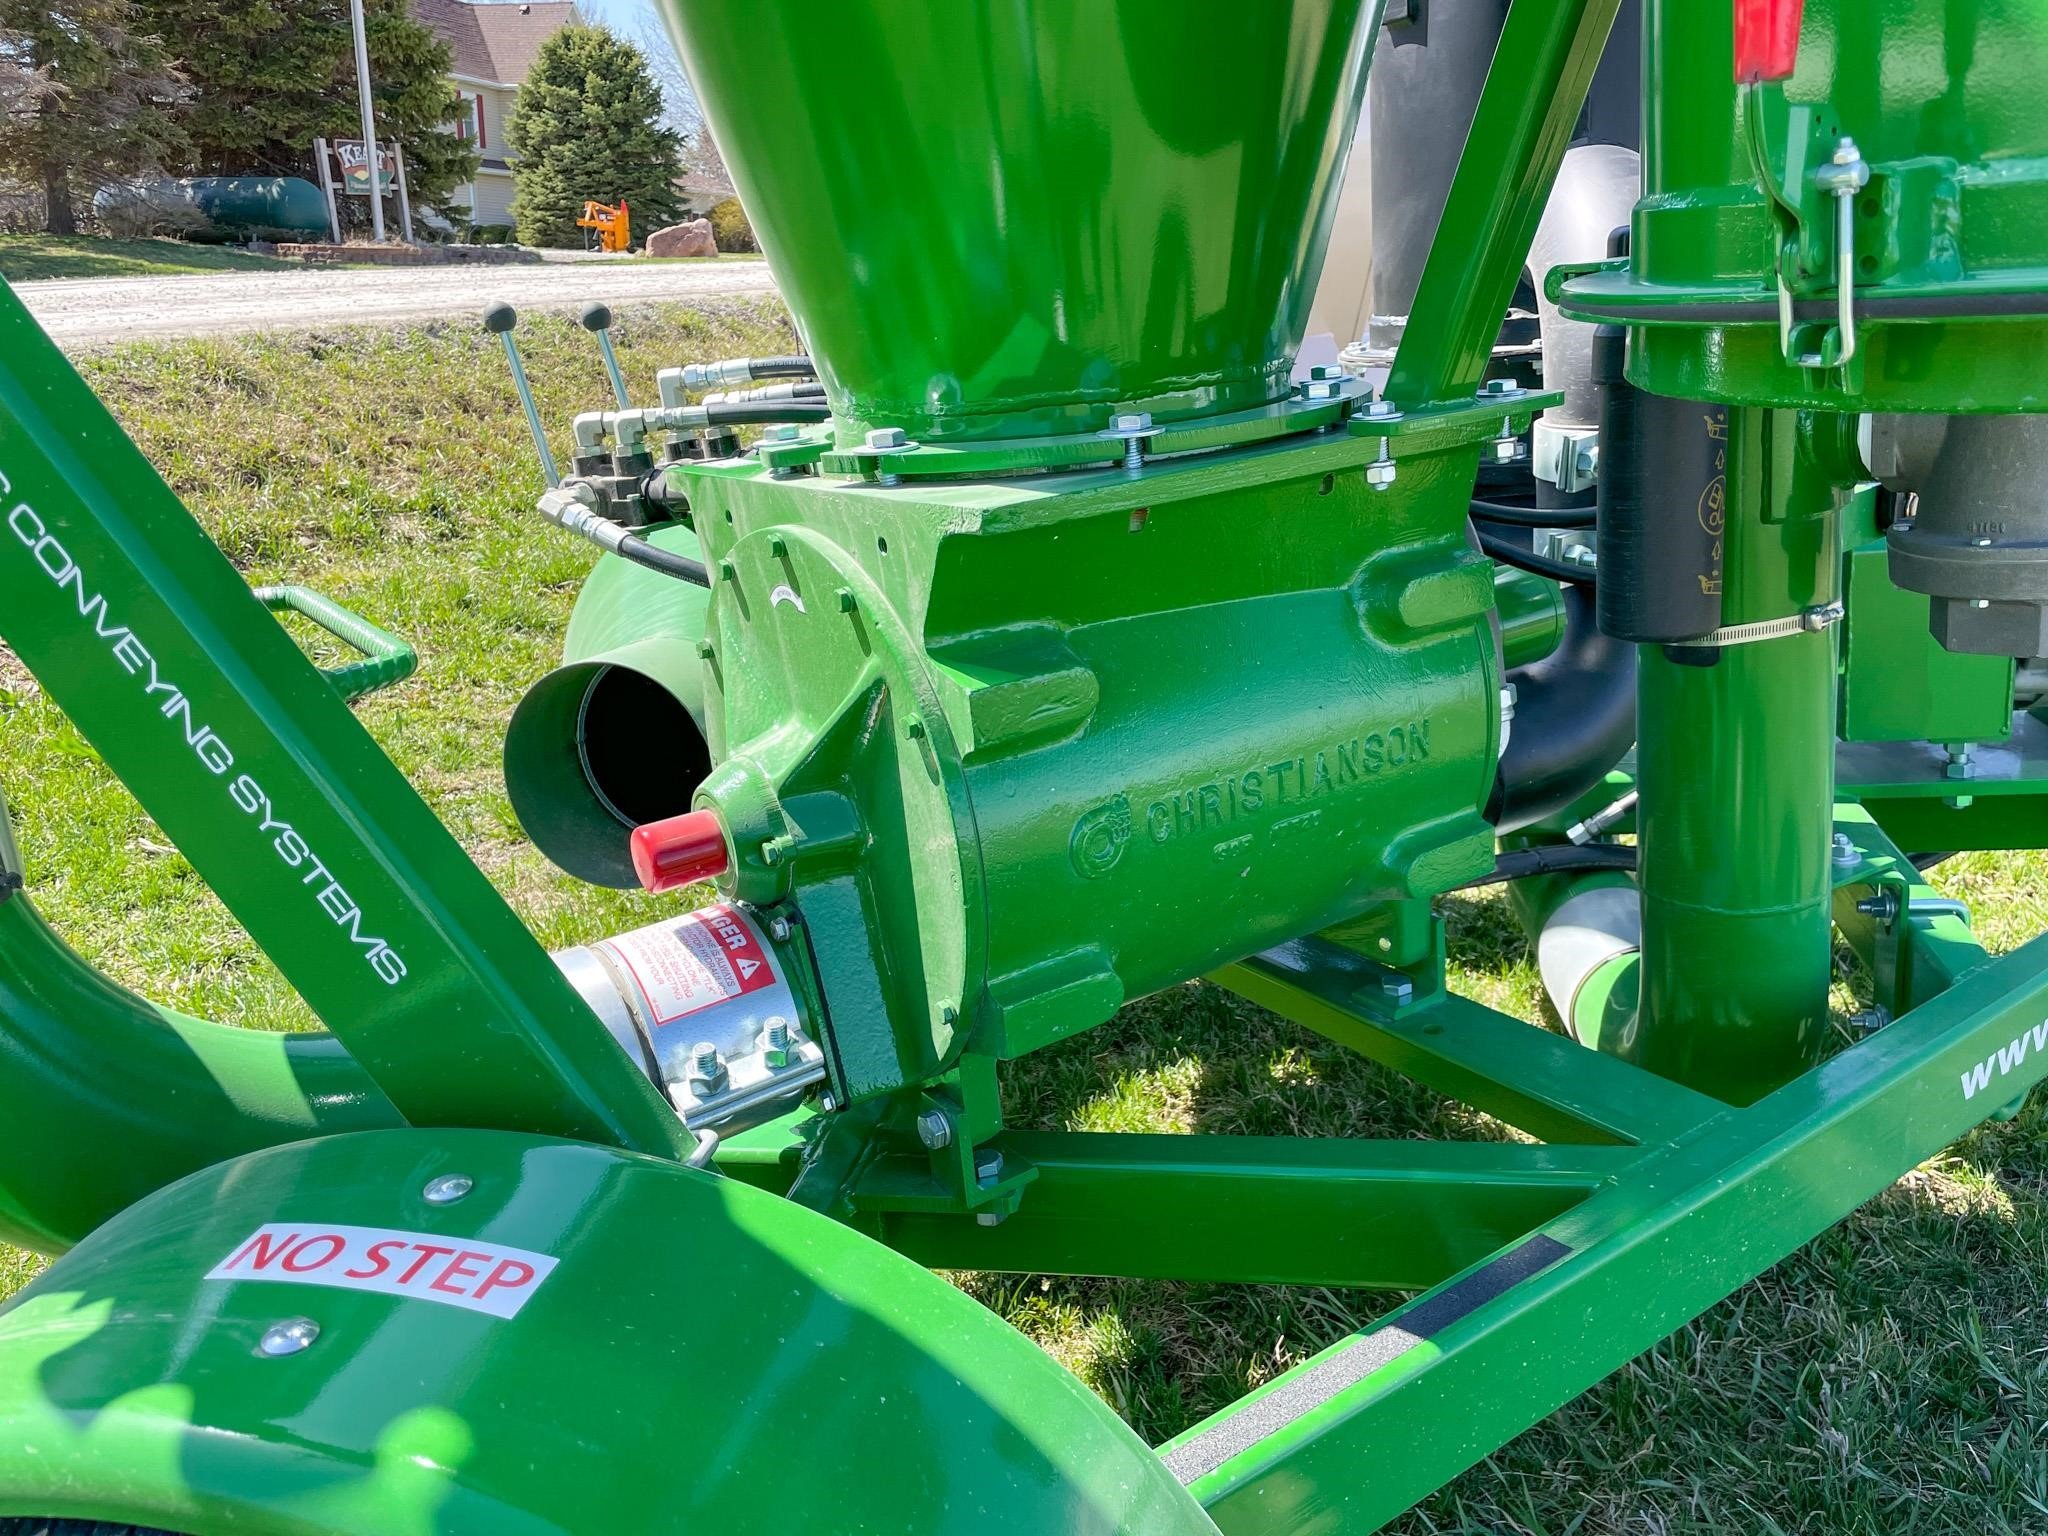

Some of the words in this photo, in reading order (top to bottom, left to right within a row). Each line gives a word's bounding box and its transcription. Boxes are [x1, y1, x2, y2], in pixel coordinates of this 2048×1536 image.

[9, 504, 234, 774] CONVEYING
[229, 774, 408, 985] SYSTEMS
[1147, 719, 1431, 842] CHRISTIANSON
[669, 960, 694, 998] SHUTTING
[677, 952, 701, 986] CYCLONE
[700, 948, 728, 995] HYDRAULICS
[714, 957, 735, 987] ALWAYS
[224, 1233, 346, 1273] NO
[344, 1240, 536, 1300] STEP
